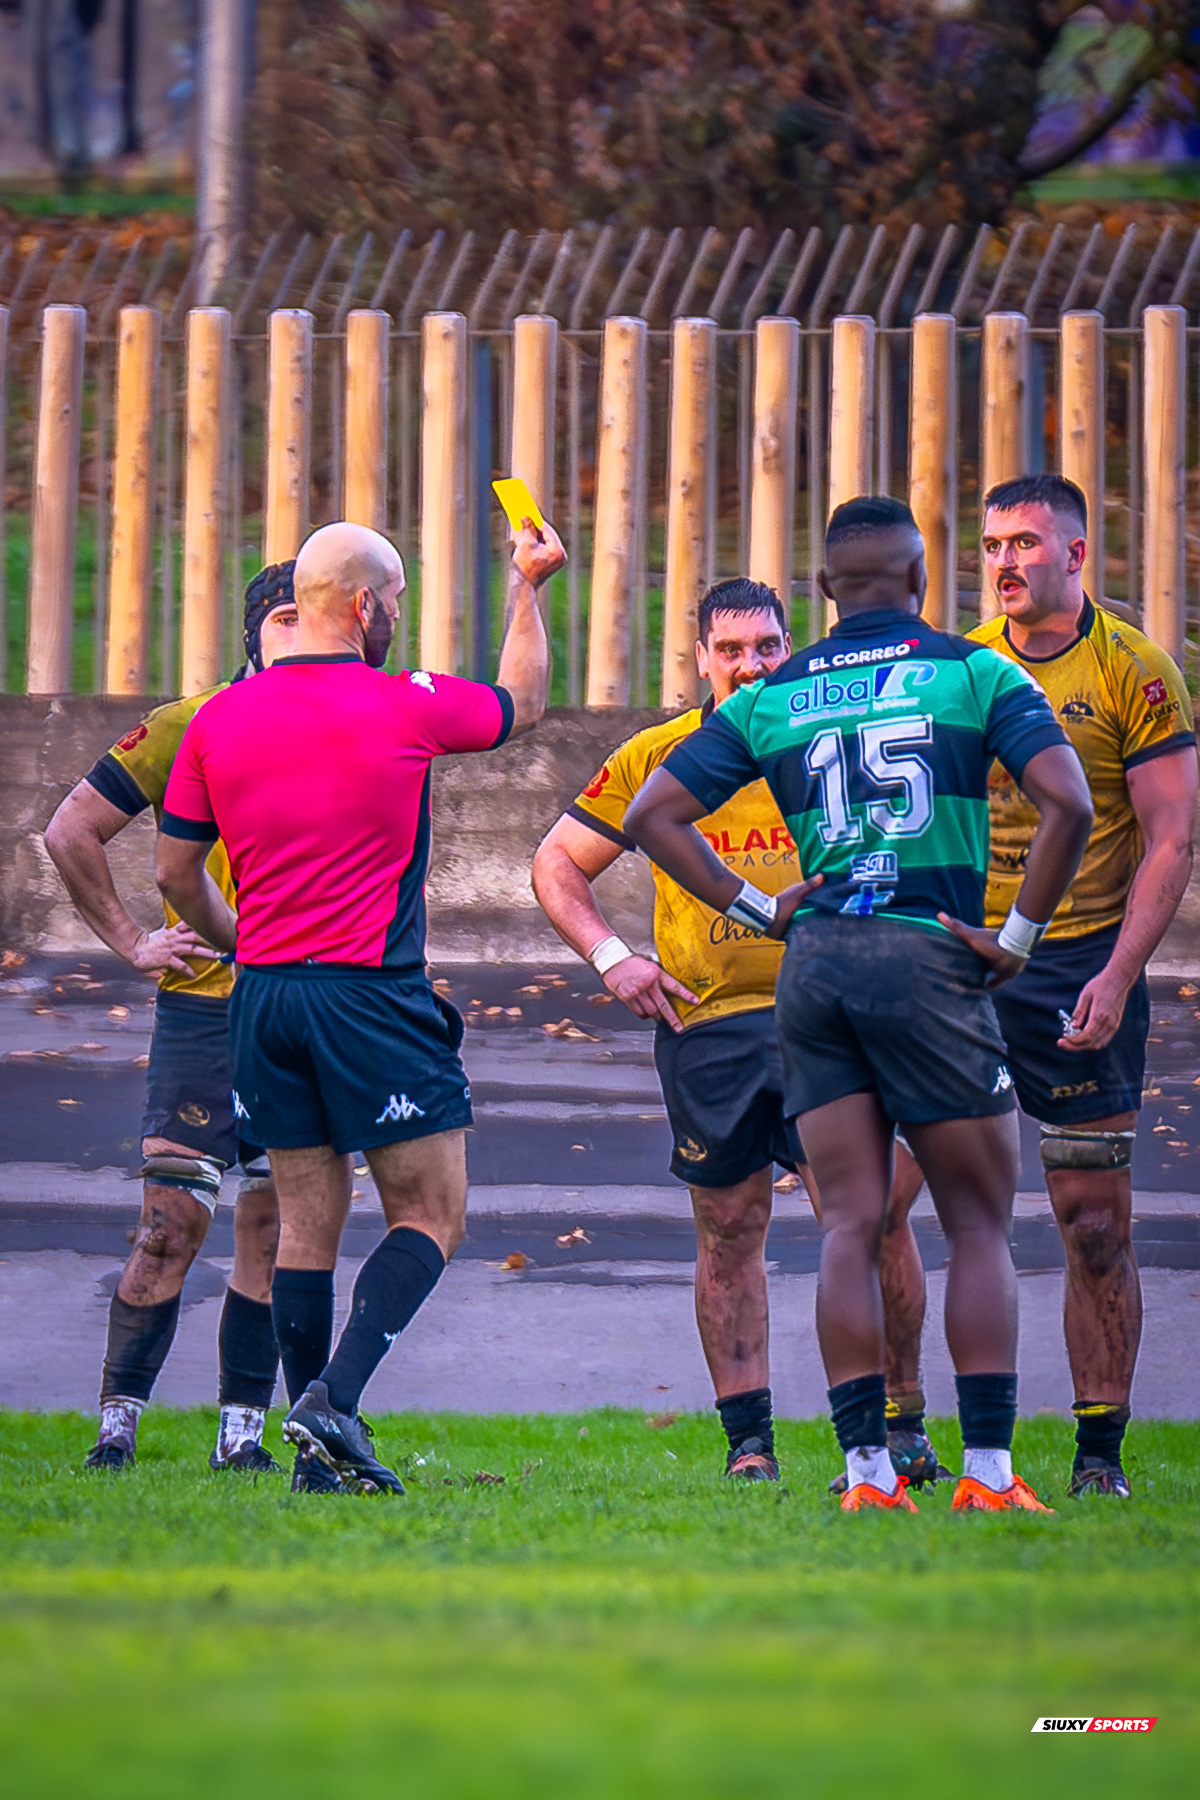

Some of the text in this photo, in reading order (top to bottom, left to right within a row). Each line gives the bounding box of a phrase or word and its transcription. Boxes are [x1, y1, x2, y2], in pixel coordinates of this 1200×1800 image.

[807, 643, 911, 672] EL CORREO
[789, 673, 870, 714] alba
[804, 714, 935, 848] 15
